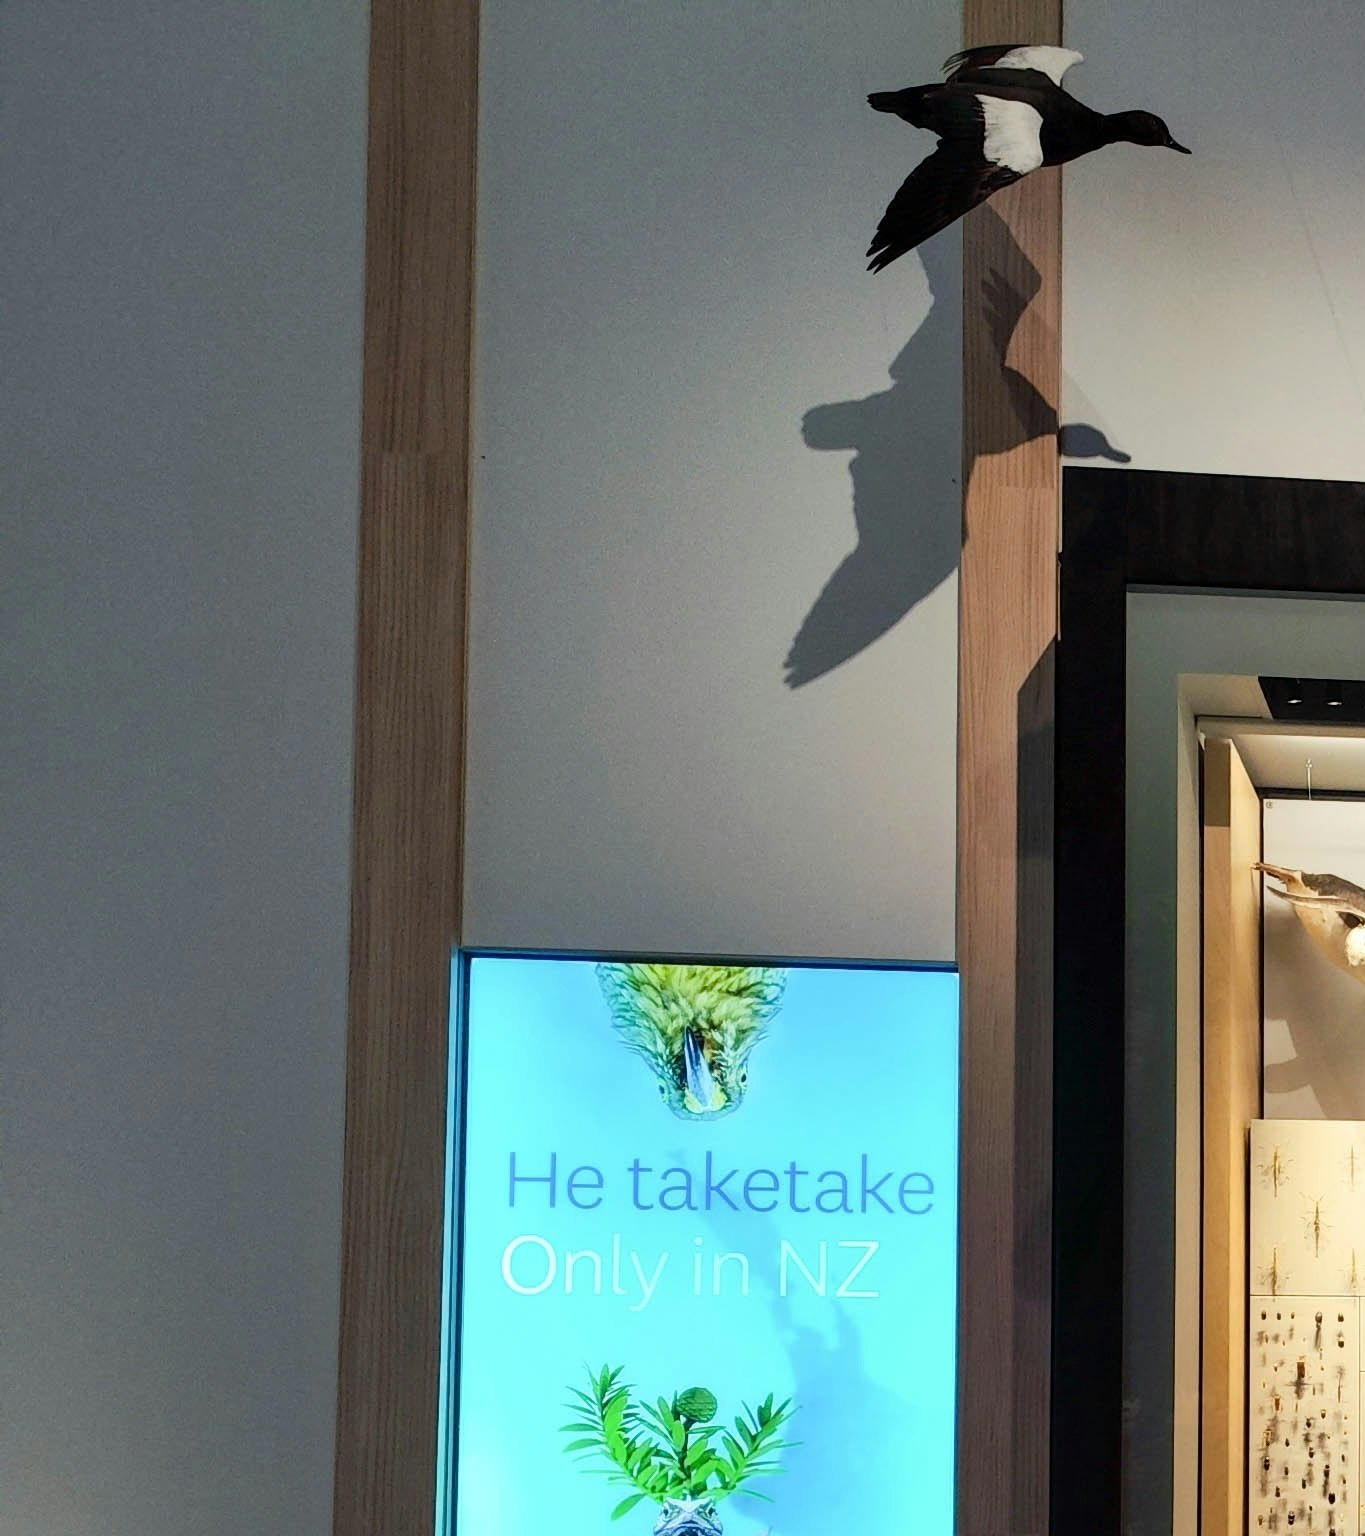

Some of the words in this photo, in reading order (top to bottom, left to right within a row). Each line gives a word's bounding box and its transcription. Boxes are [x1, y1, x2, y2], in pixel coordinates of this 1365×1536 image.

[509, 1152, 603, 1209] He
[628, 1151, 934, 1214] taketake
[502, 1233, 668, 1311] Only
[694, 1236, 749, 1295] in
[780, 1240, 880, 1297] NZ
